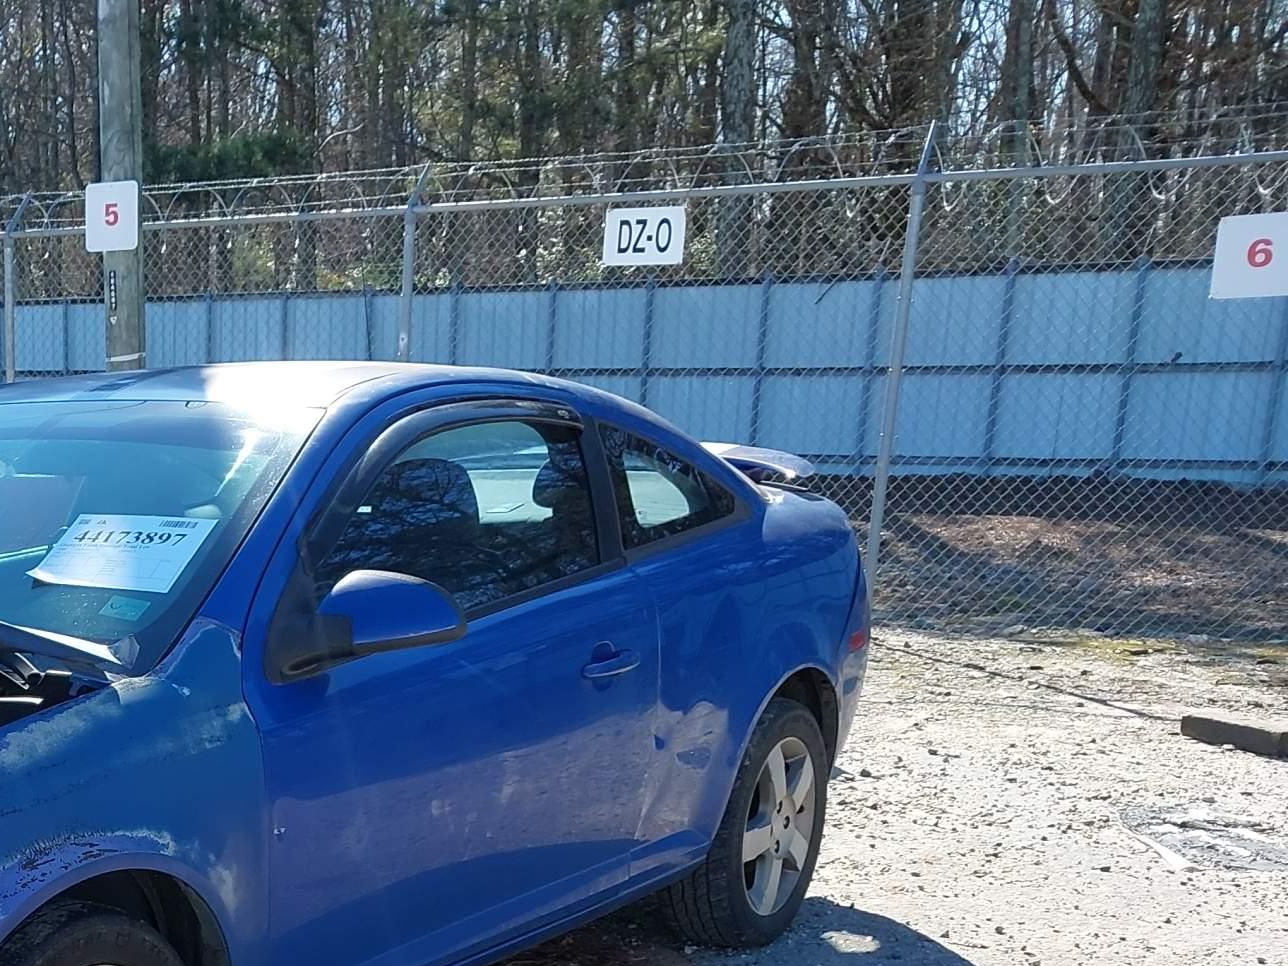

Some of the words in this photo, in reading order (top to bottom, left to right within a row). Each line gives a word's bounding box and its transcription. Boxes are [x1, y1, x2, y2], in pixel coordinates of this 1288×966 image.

[104, 203, 119, 227] 5
[1247, 238, 1274, 268] 6
[73, 529, 188, 547] 44173897
